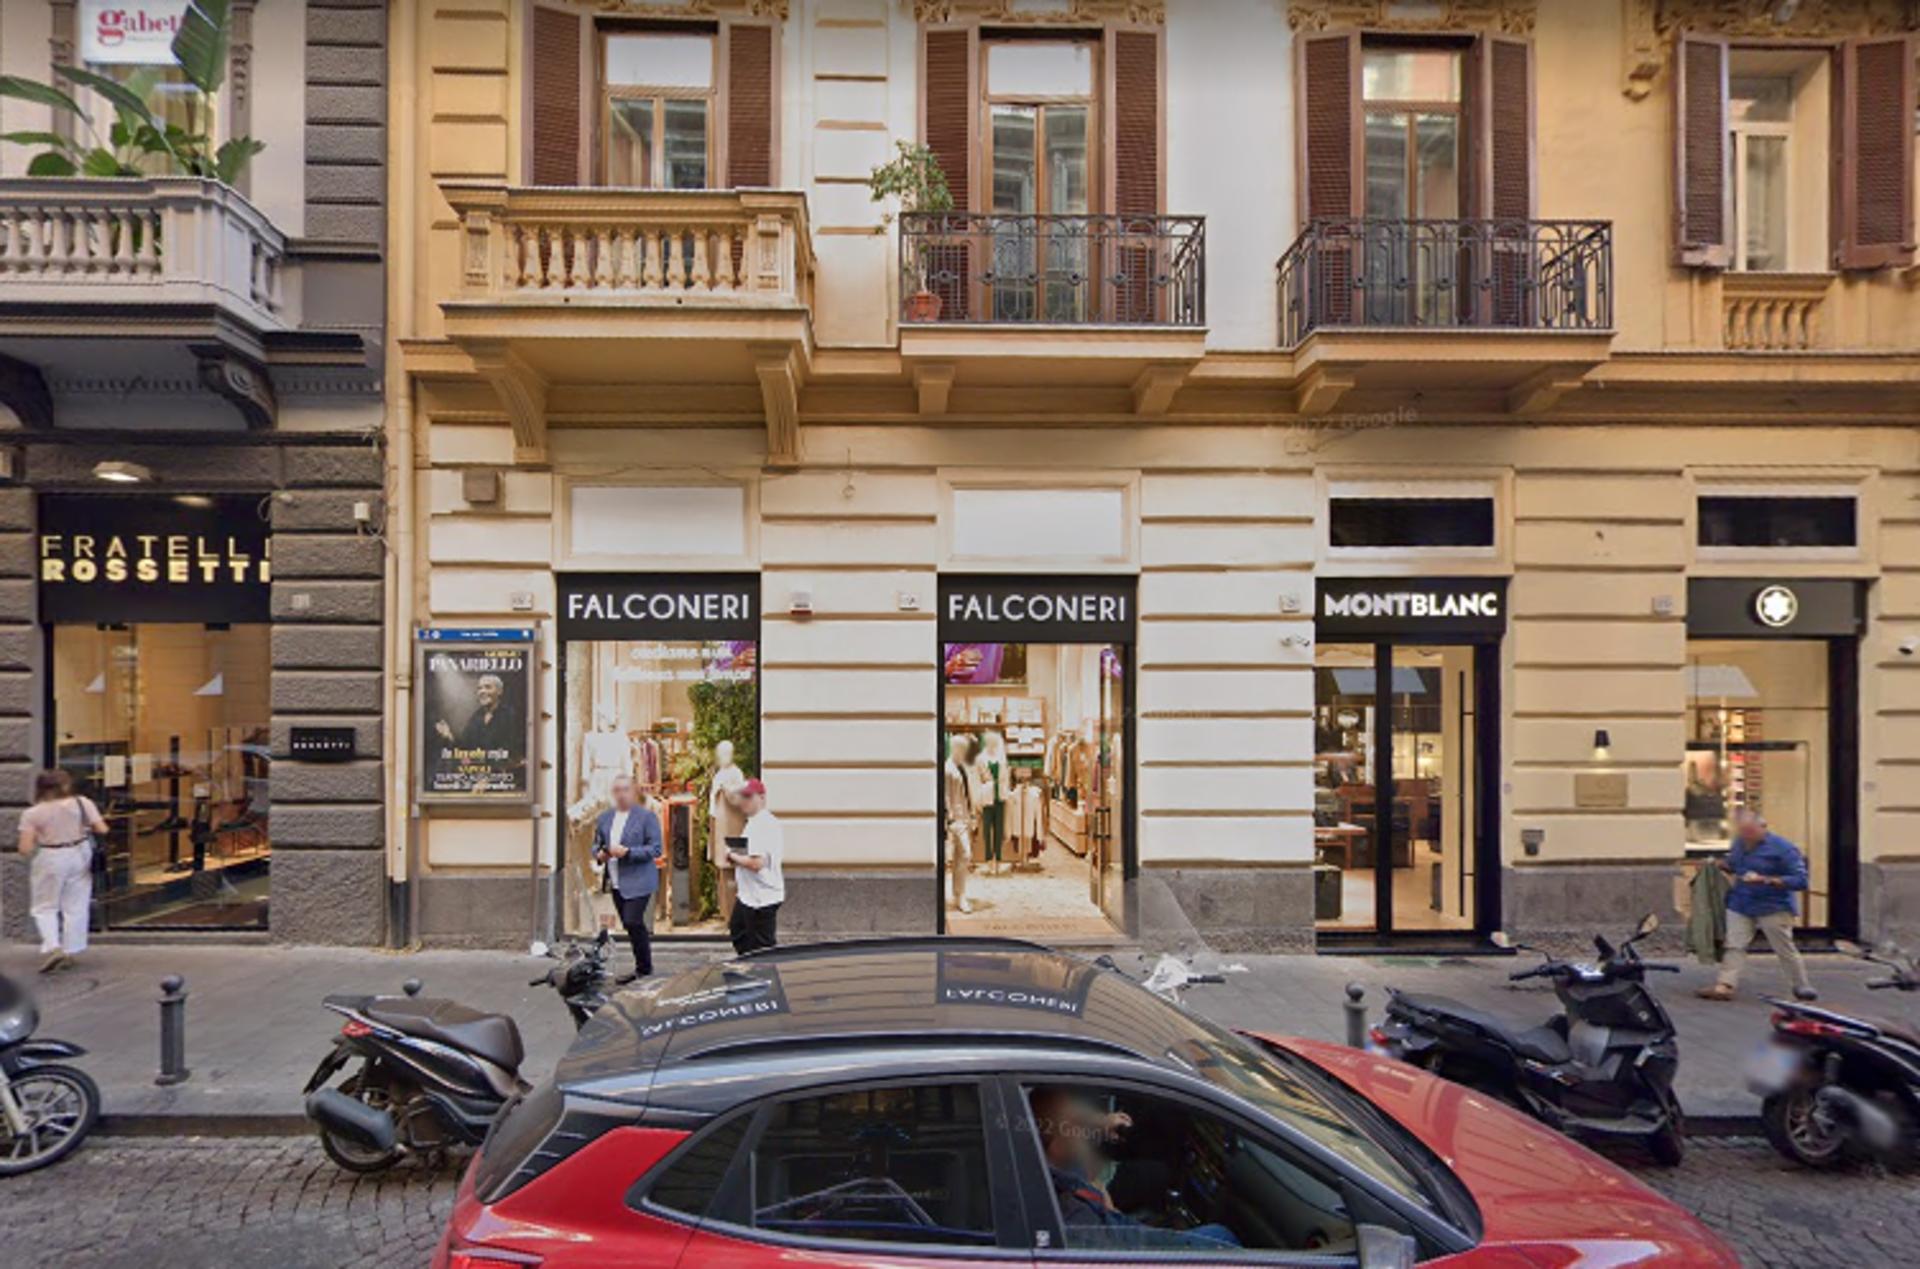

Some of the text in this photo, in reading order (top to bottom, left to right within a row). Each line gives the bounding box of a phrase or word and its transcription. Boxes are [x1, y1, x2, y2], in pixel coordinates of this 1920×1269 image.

[42, 536, 270, 558] FRATELLI
[42, 560, 270, 582] ROSSETTI
[568, 593, 749, 620] FALCONERI
[948, 594, 1125, 622] FALCONERI
[1324, 592, 1498, 617] MONTBLANC
